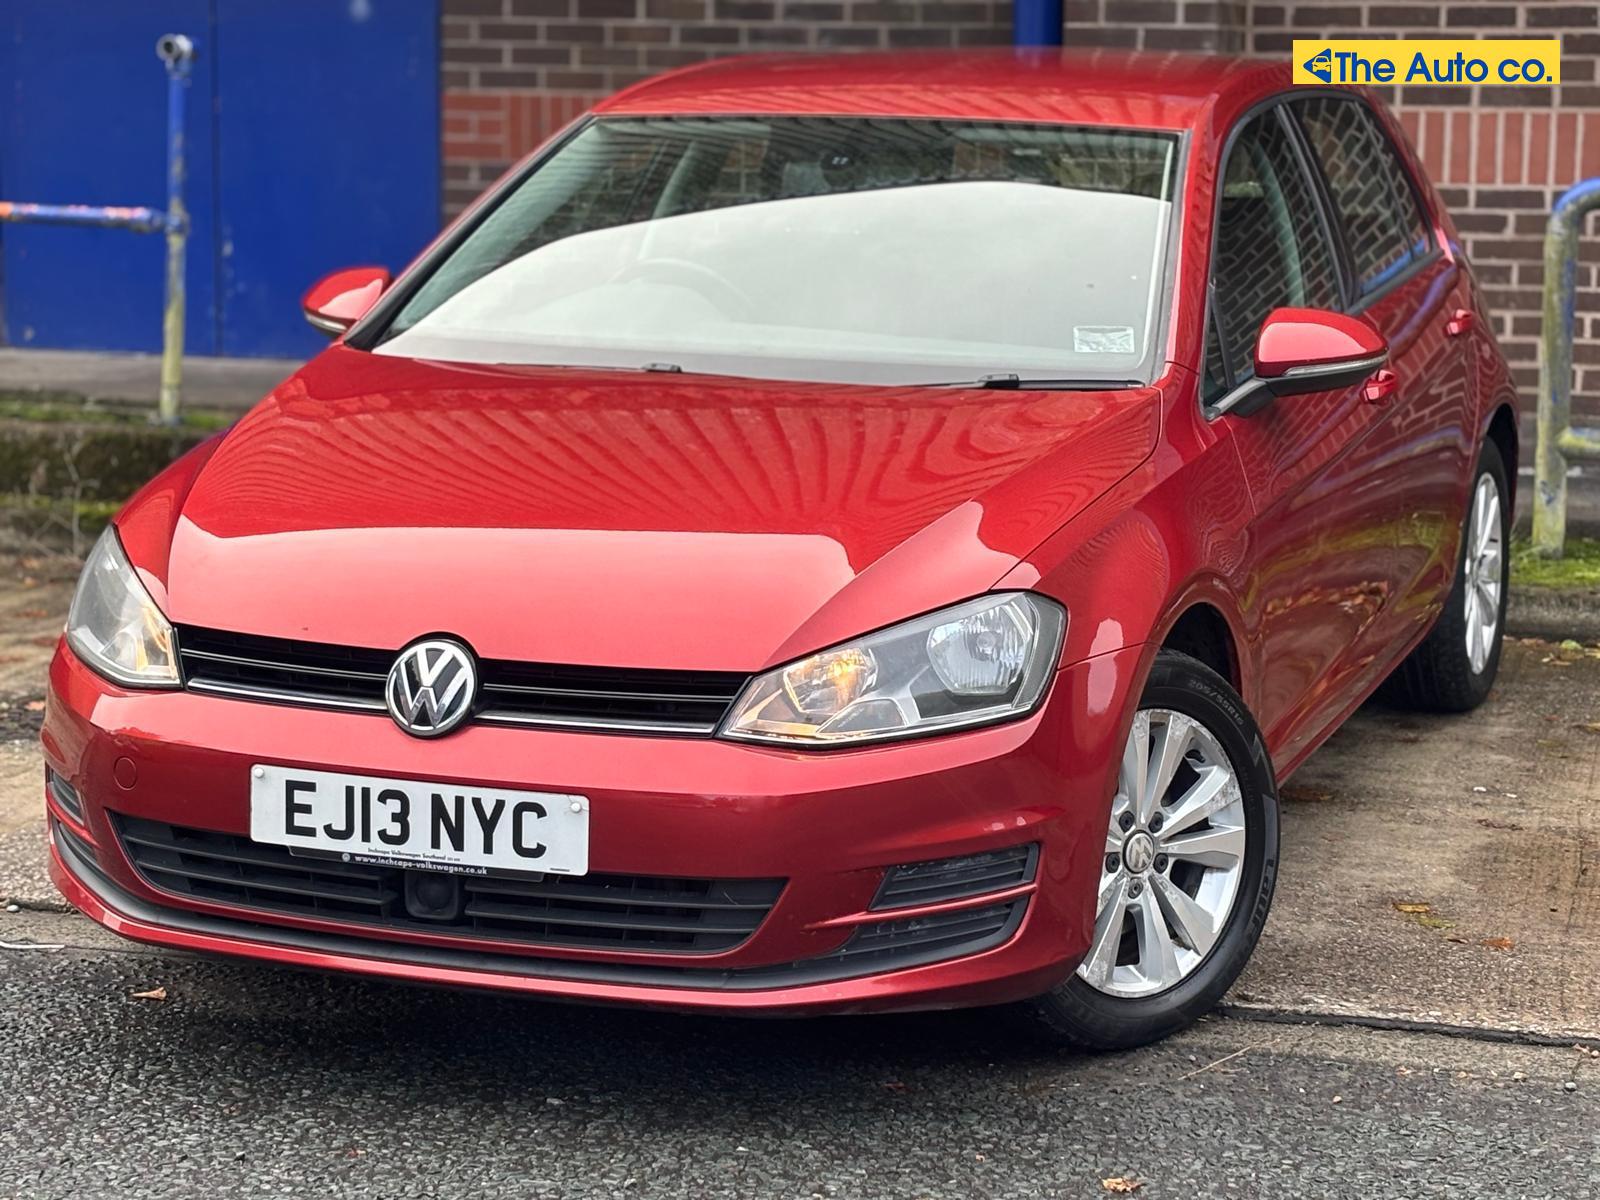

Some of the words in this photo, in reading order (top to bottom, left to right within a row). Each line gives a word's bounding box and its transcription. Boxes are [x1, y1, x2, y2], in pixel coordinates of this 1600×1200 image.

[285, 779, 410, 846] EJ13
[430, 792, 548, 859] NYC
[354, 855, 488, 875] www.inchcape-volkswagen.co.uk
